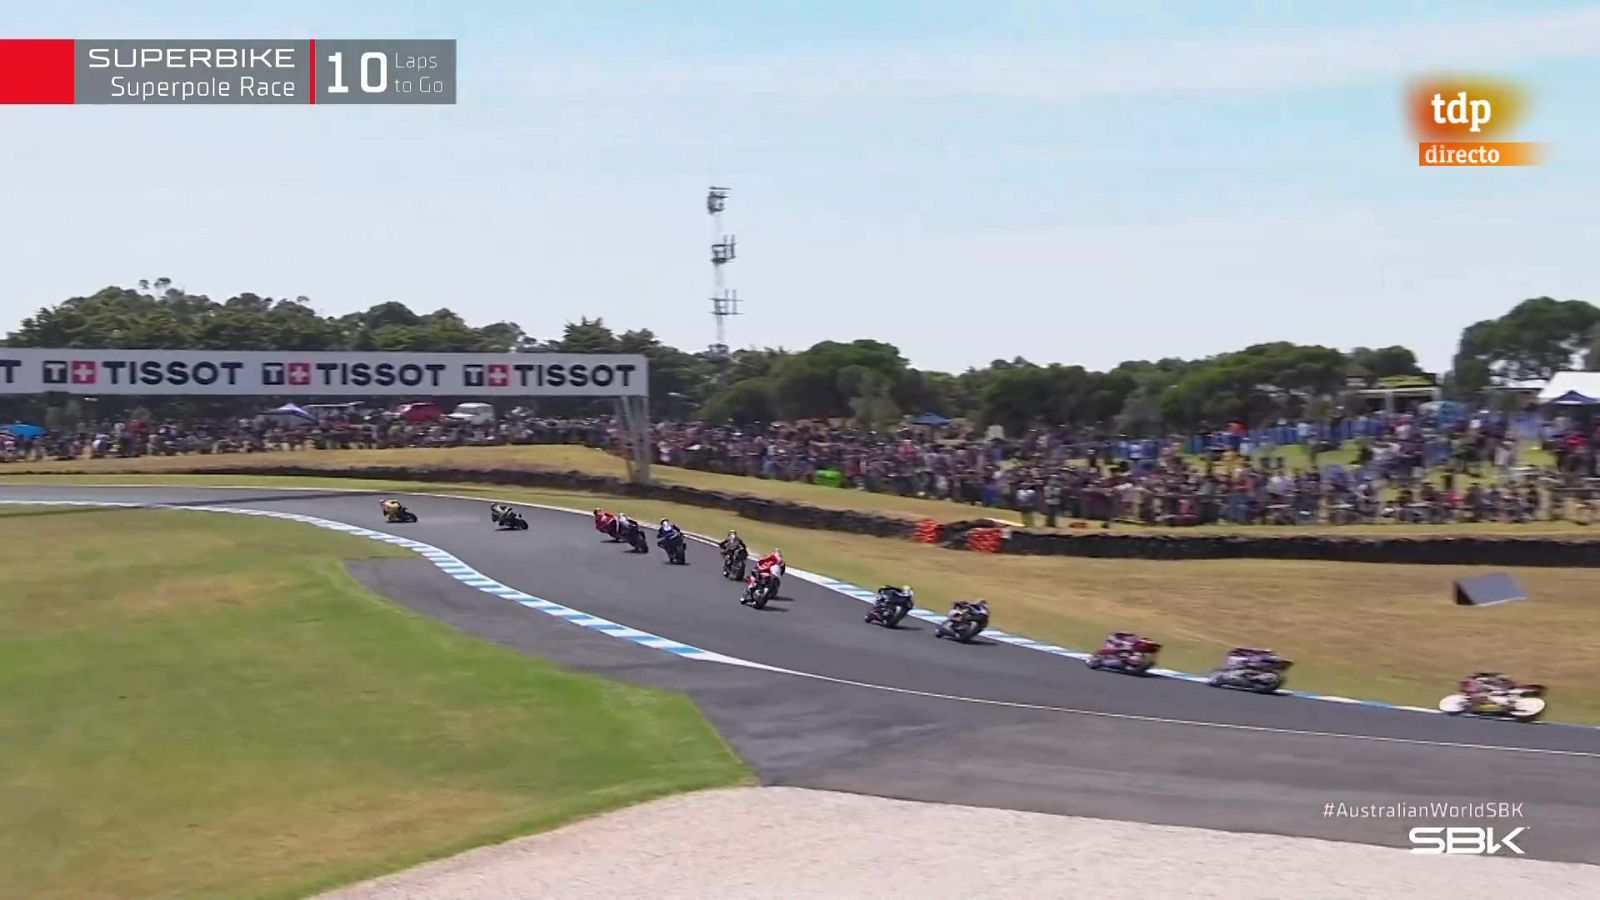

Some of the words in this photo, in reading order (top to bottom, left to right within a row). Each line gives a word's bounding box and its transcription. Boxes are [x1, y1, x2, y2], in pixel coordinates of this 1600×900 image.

[102, 360, 243, 385] TISSOT
[316, 363, 446, 386] TISSOT
[514, 364, 636, 387] TISSOT
